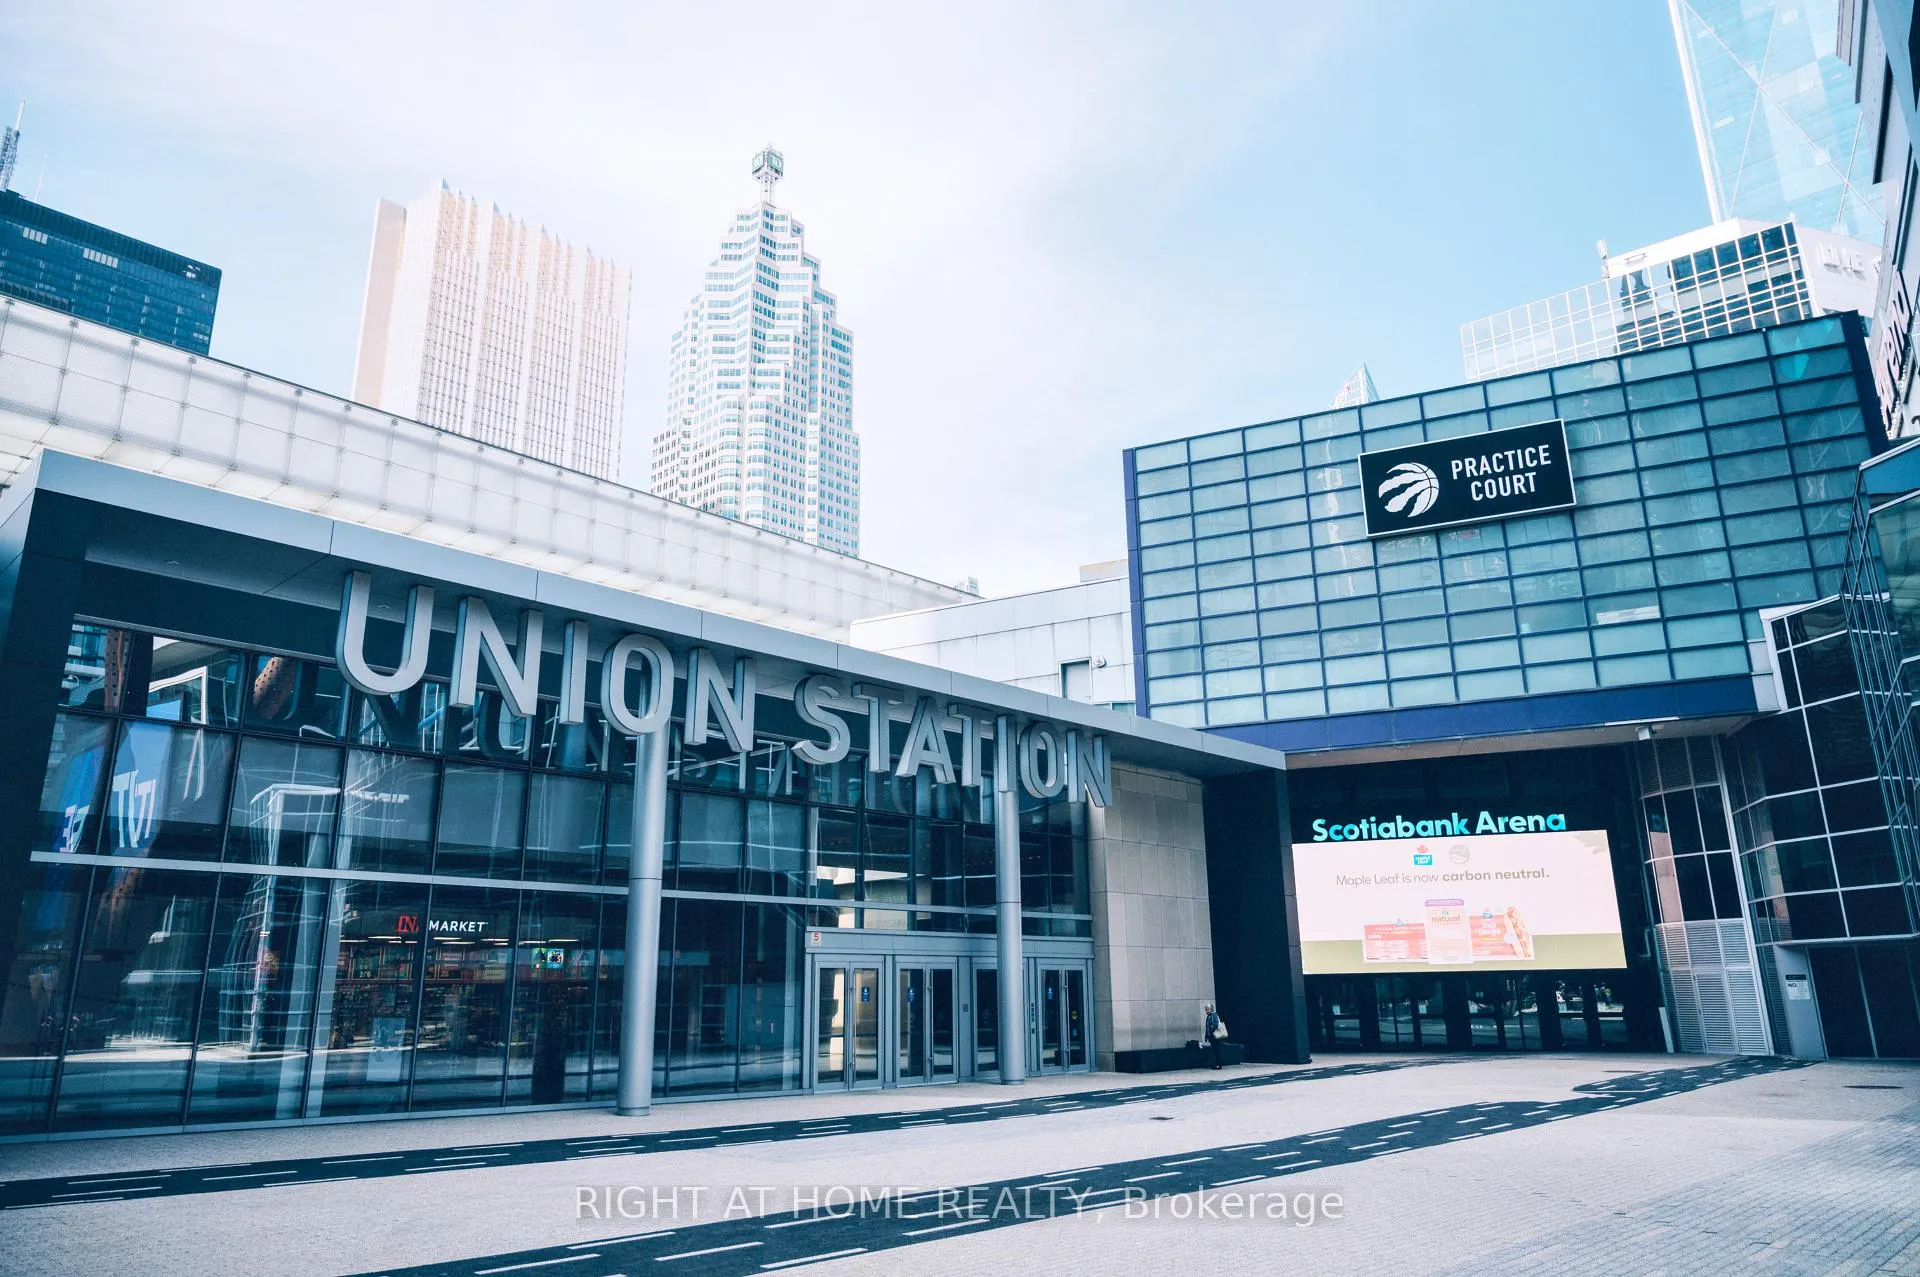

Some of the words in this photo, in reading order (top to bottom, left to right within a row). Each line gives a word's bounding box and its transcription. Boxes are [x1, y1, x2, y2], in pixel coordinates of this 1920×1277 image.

[1451, 444, 1552, 480] PRACTICE
[1470, 471, 1537, 502] COURT
[336, 571, 757, 752] UNION
[790, 671, 1113, 808] STATION
[1312, 812, 1471, 842] Scotiabank
[1475, 810, 1567, 834] Arena
[1336, 874, 1372, 888] Maple
[1374, 873, 1401, 884] Leaf
[1402, 873, 1412, 884] is
[1413, 874, 1439, 884] now
[1442, 870, 1491, 882] carbon
[1495, 868, 1550, 880] neutral.
[429, 920, 486, 932] MARKET
[813, 933, 819, 941] 5
